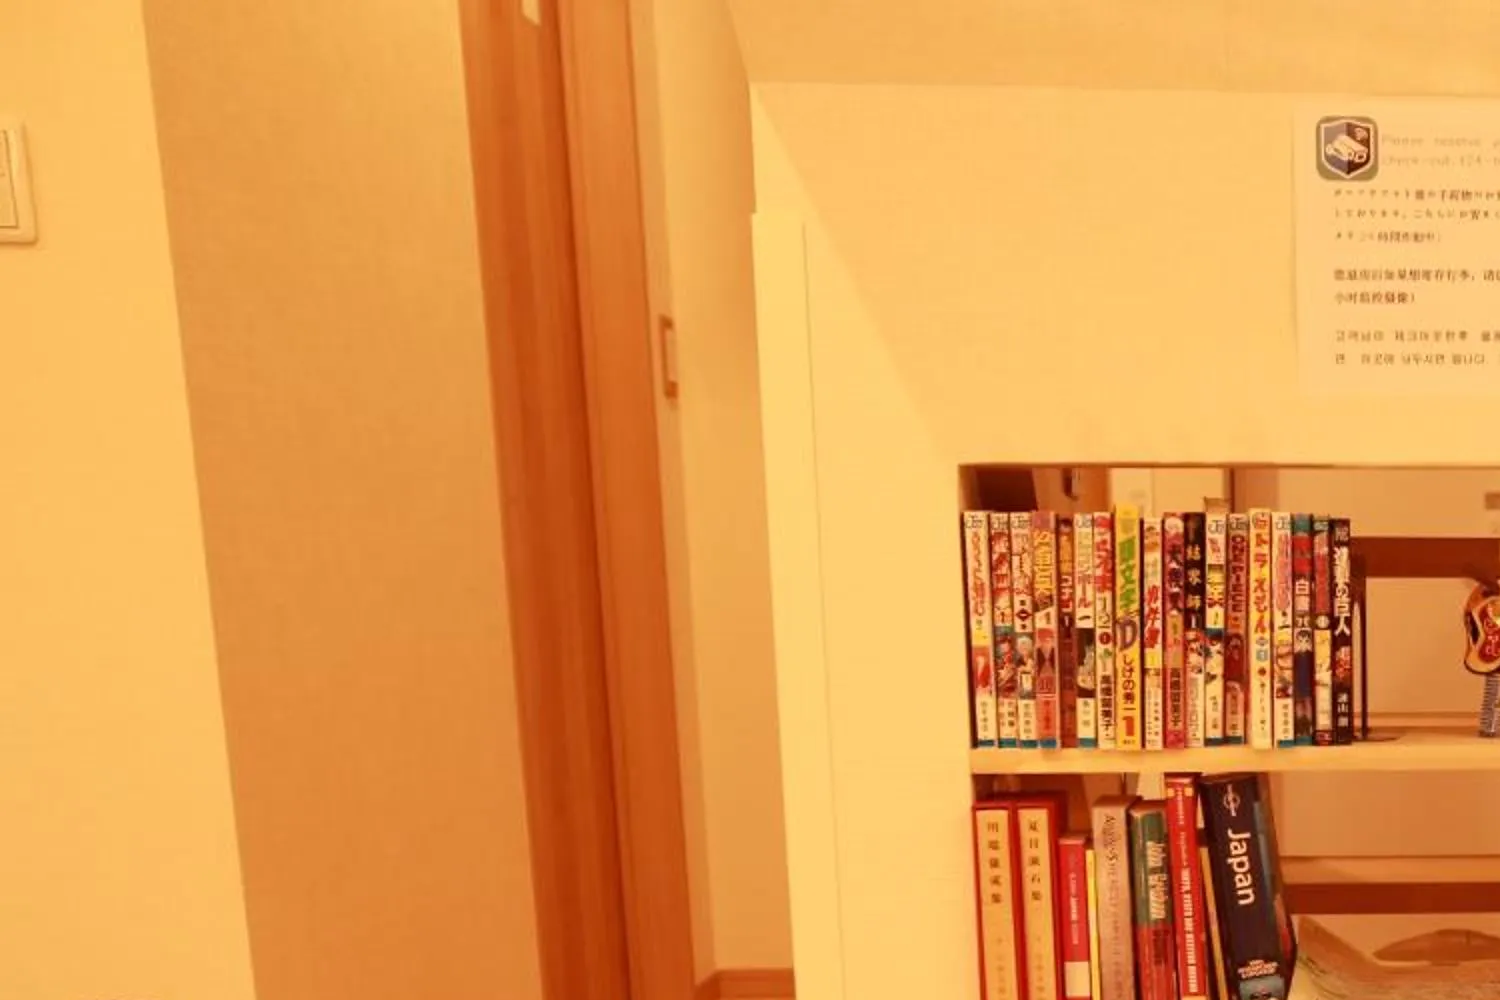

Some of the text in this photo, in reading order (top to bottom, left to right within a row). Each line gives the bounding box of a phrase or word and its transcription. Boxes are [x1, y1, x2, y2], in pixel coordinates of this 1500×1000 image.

[1333, 546, 1351, 637] 進撃の巨人
[1226, 828, 1255, 905] Japan
